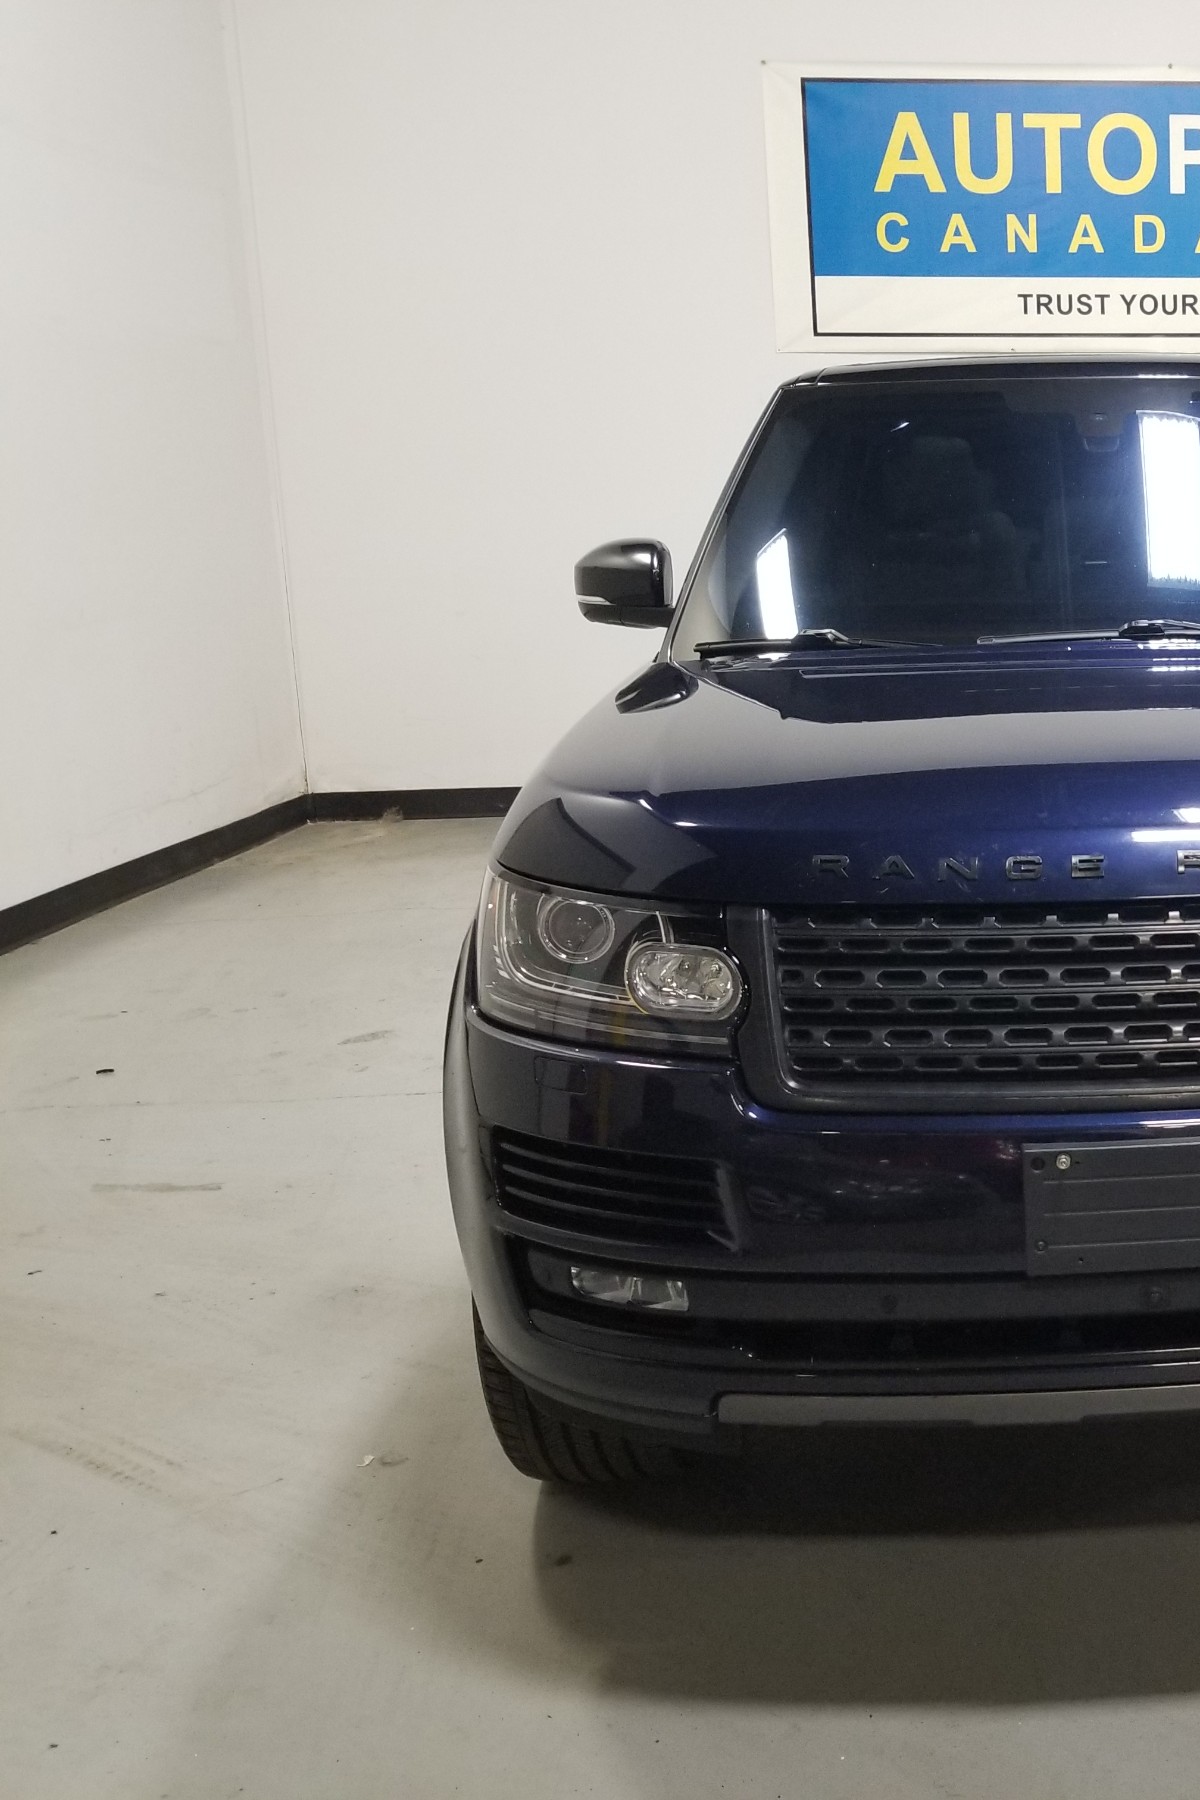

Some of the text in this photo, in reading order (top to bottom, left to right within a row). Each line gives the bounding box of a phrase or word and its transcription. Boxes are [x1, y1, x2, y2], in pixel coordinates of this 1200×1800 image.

[1018, 293, 1110, 316] TRUST
[1120, 293, 1200, 316] YOUR
[811, 854, 1106, 880] RANGE
